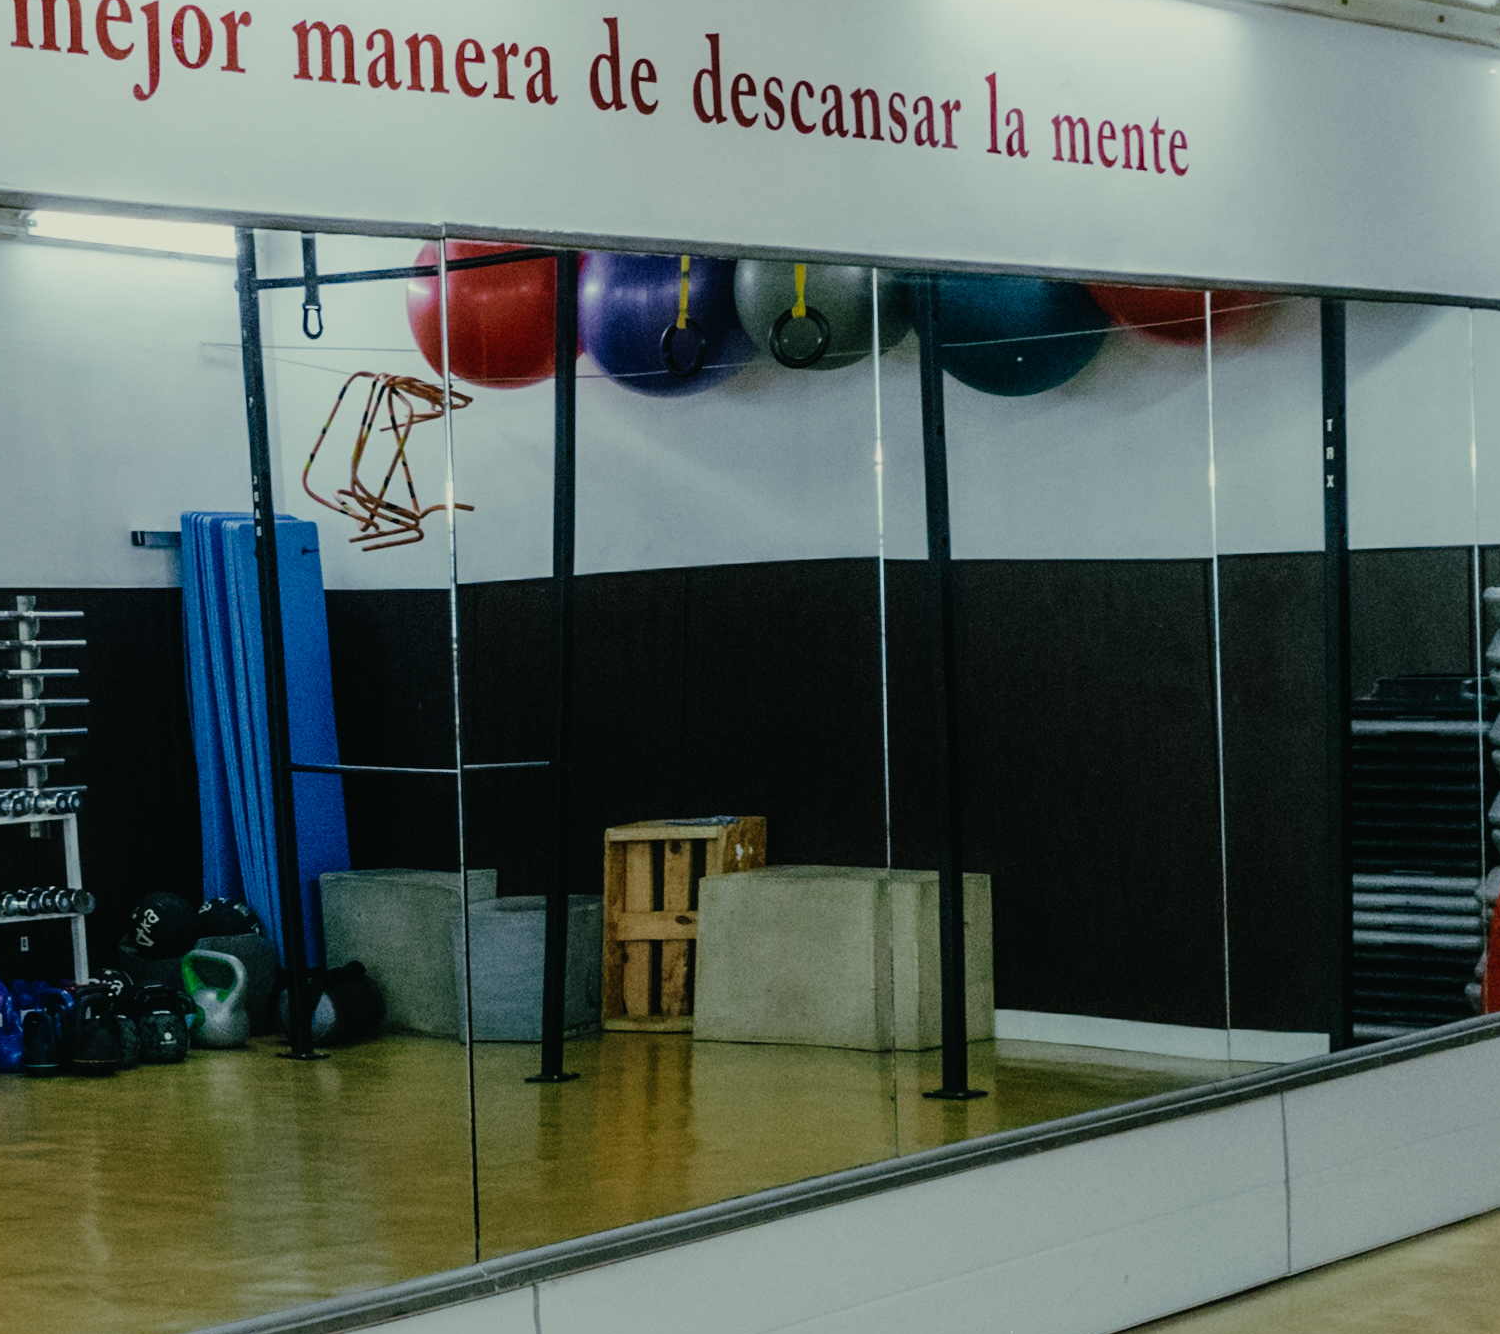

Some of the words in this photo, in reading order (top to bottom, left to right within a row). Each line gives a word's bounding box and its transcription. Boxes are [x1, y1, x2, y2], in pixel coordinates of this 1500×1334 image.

[293, 21, 559, 107] manera
[590, 18, 659, 116] de
[692, 33, 962, 151] descansar
[986, 73, 1030, 160] la
[1051, 113, 1191, 178] mente
